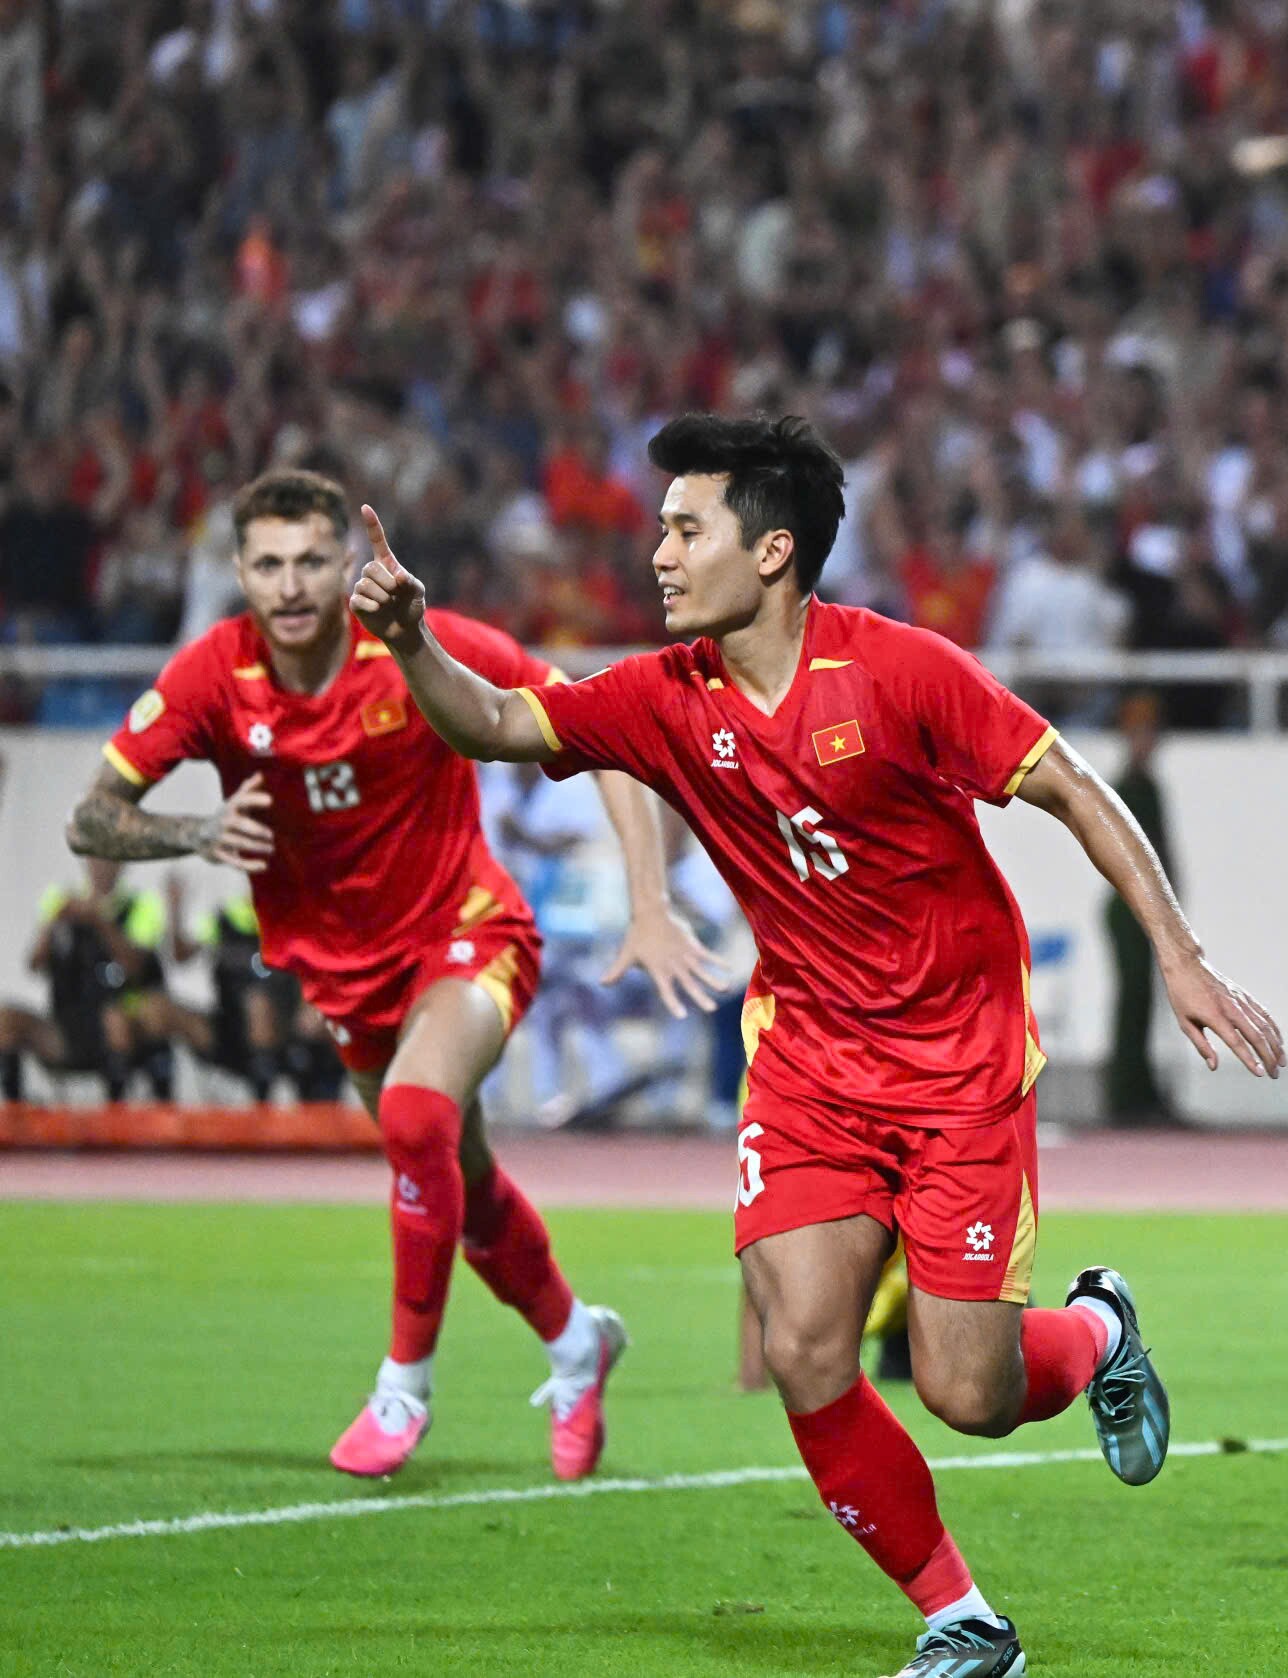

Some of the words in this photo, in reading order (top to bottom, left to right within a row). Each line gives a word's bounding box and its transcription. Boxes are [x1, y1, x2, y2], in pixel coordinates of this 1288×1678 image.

[304, 761, 361, 813] 13
[776, 805, 849, 882] 15
[734, 1122, 765, 1214] 5
